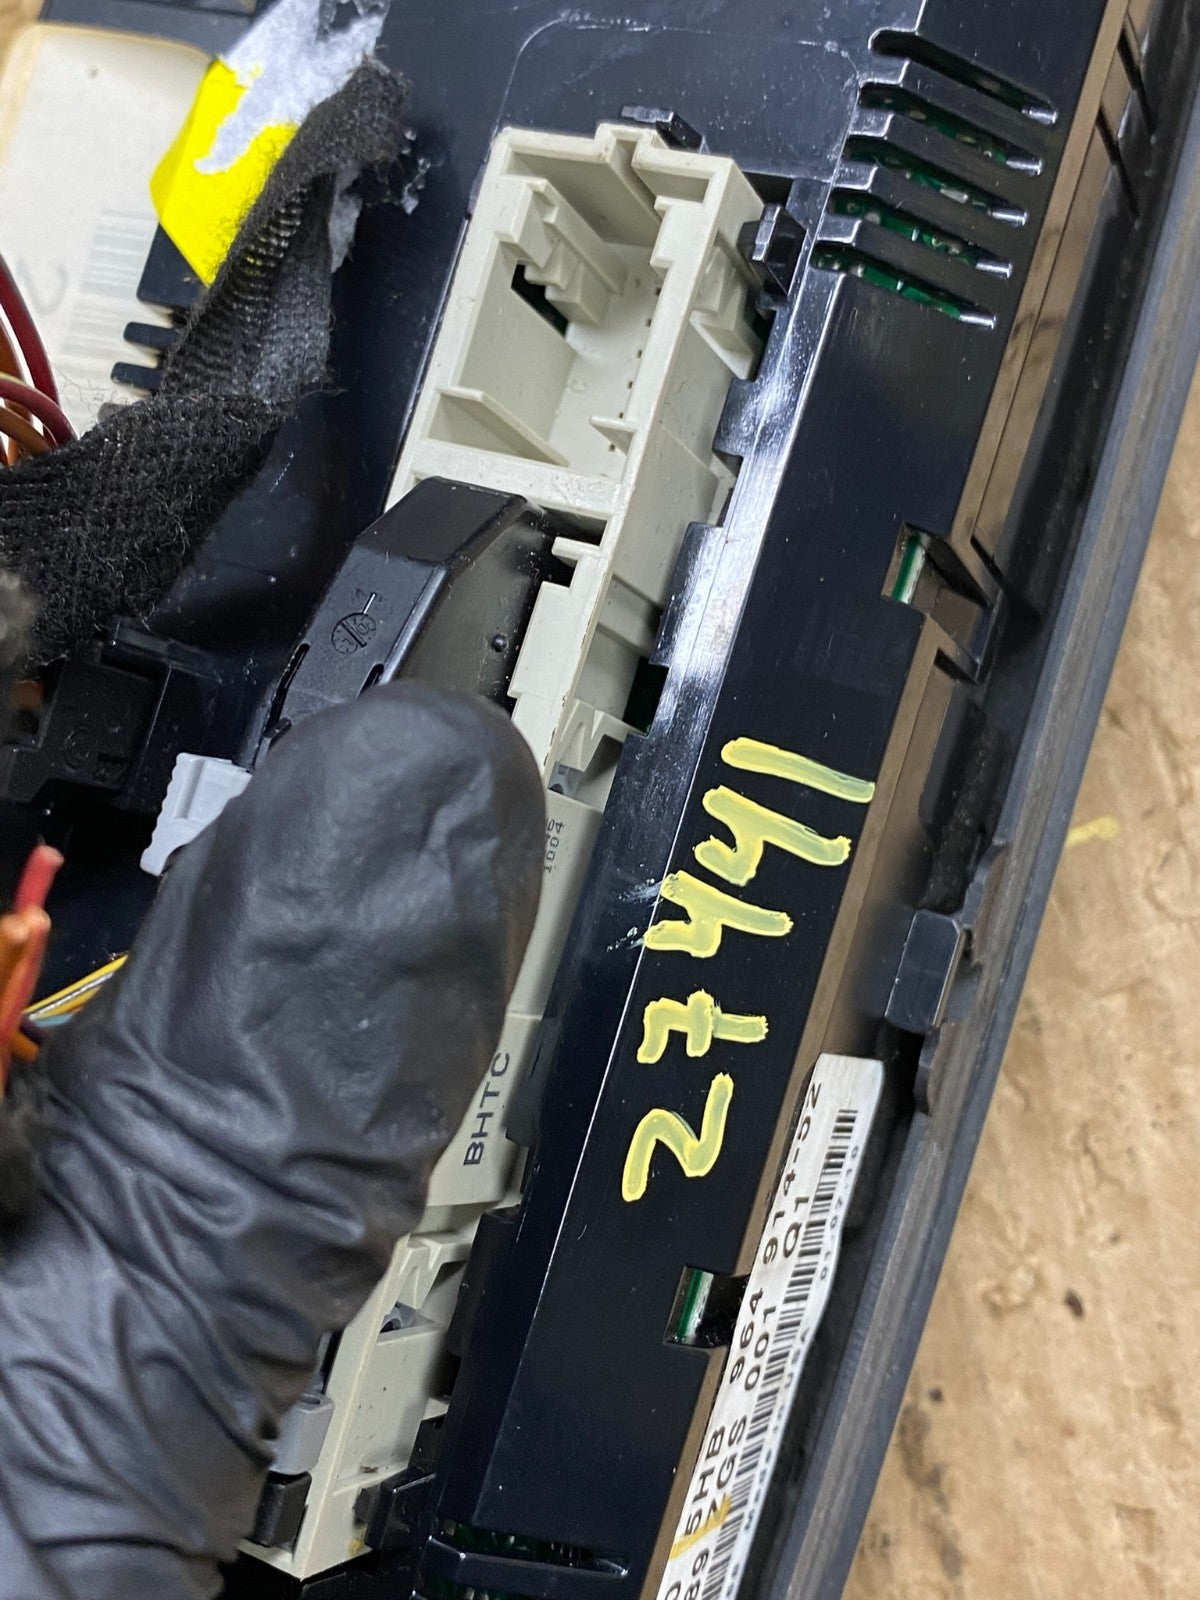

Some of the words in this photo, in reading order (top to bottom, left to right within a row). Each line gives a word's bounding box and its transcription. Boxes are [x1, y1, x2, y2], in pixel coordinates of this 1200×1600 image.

[464, 1051, 511, 1165] BHTC
[622, 737, 875, 1202] 27441
[684, 1425, 726, 1536] 5HB
[729, 1287, 764, 1384] 964
[763, 1083, 822, 1265] 914-52
[744, 1306, 777, 1391] 001
[783, 1197, 809, 1259] Q1
